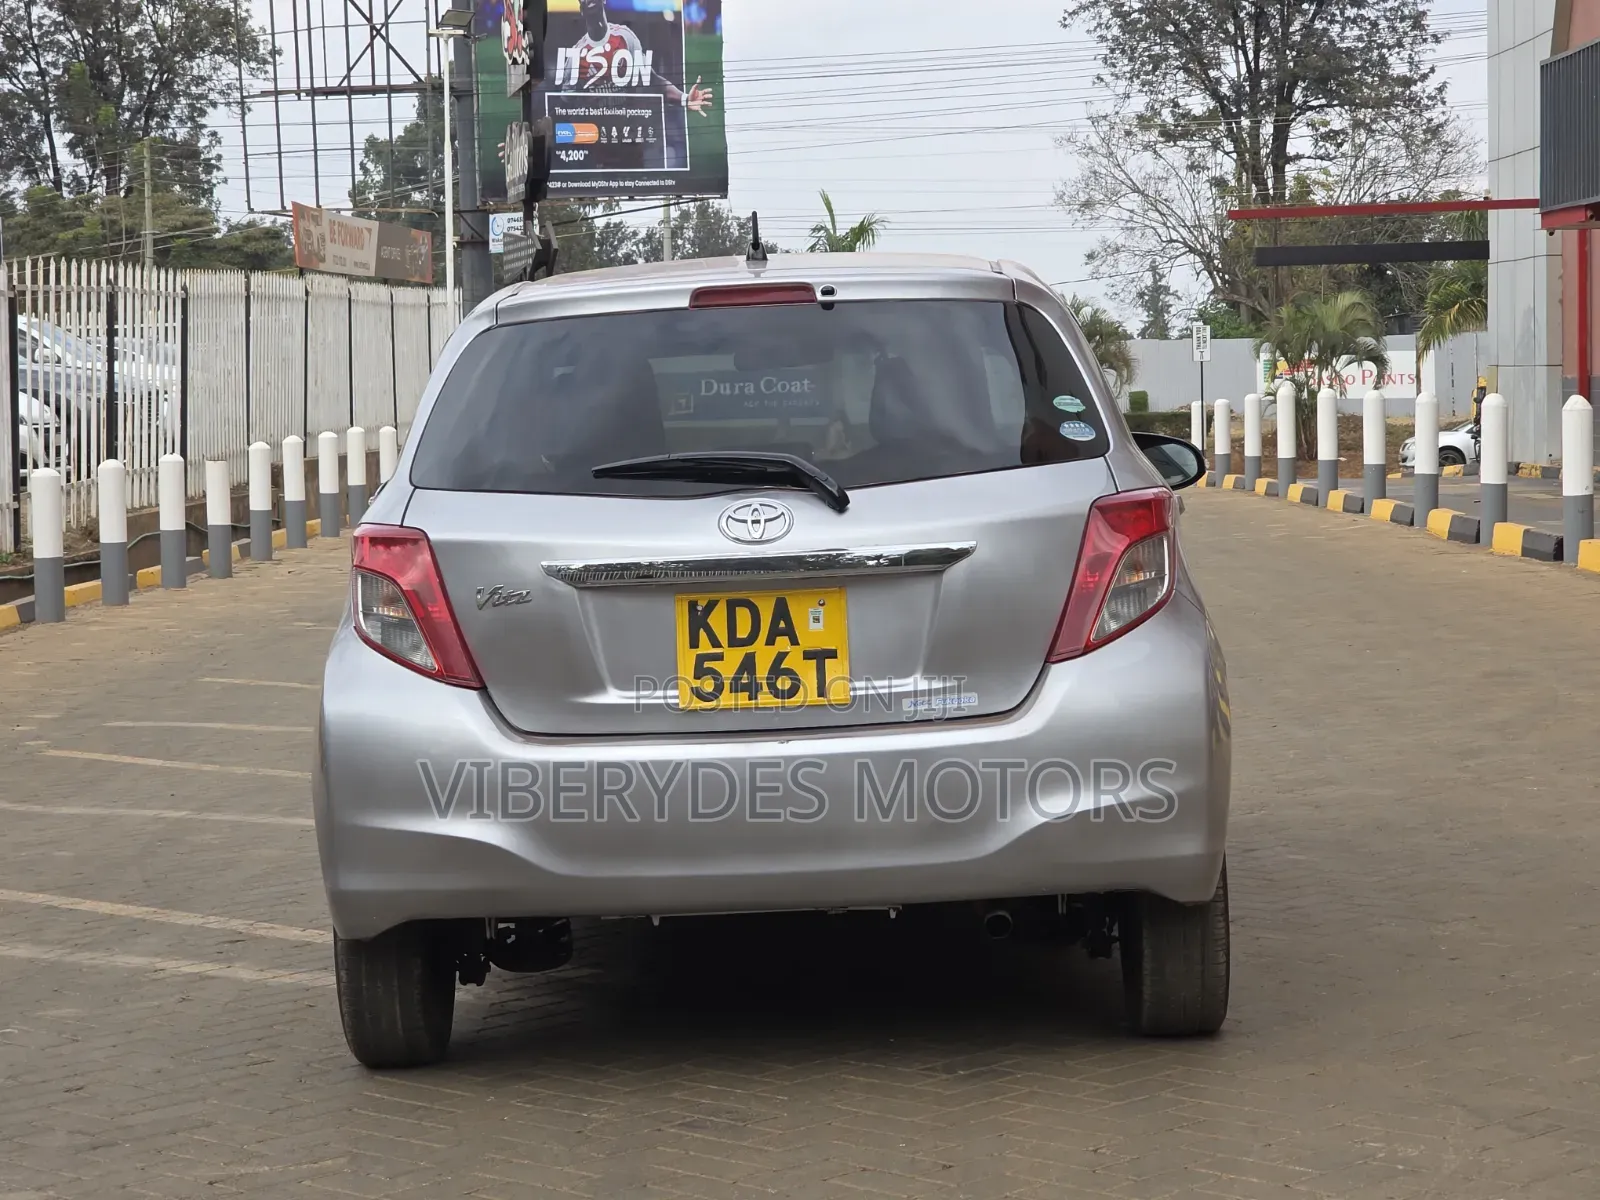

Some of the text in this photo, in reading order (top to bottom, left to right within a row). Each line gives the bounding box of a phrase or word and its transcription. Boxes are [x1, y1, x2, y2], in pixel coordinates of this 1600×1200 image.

[554, 43, 653, 89] IT'S ON
[554, 106, 652, 118] The world's best football package
[567, 180, 591, 188] Download
[609, 180, 618, 188] App
[624, 179, 634, 188] stay
[635, 179, 659, 187] Connected
[700, 376, 812, 396] Dura Coat
[688, 596, 801, 650] KDA
[690, 648, 838, 703] 546T
